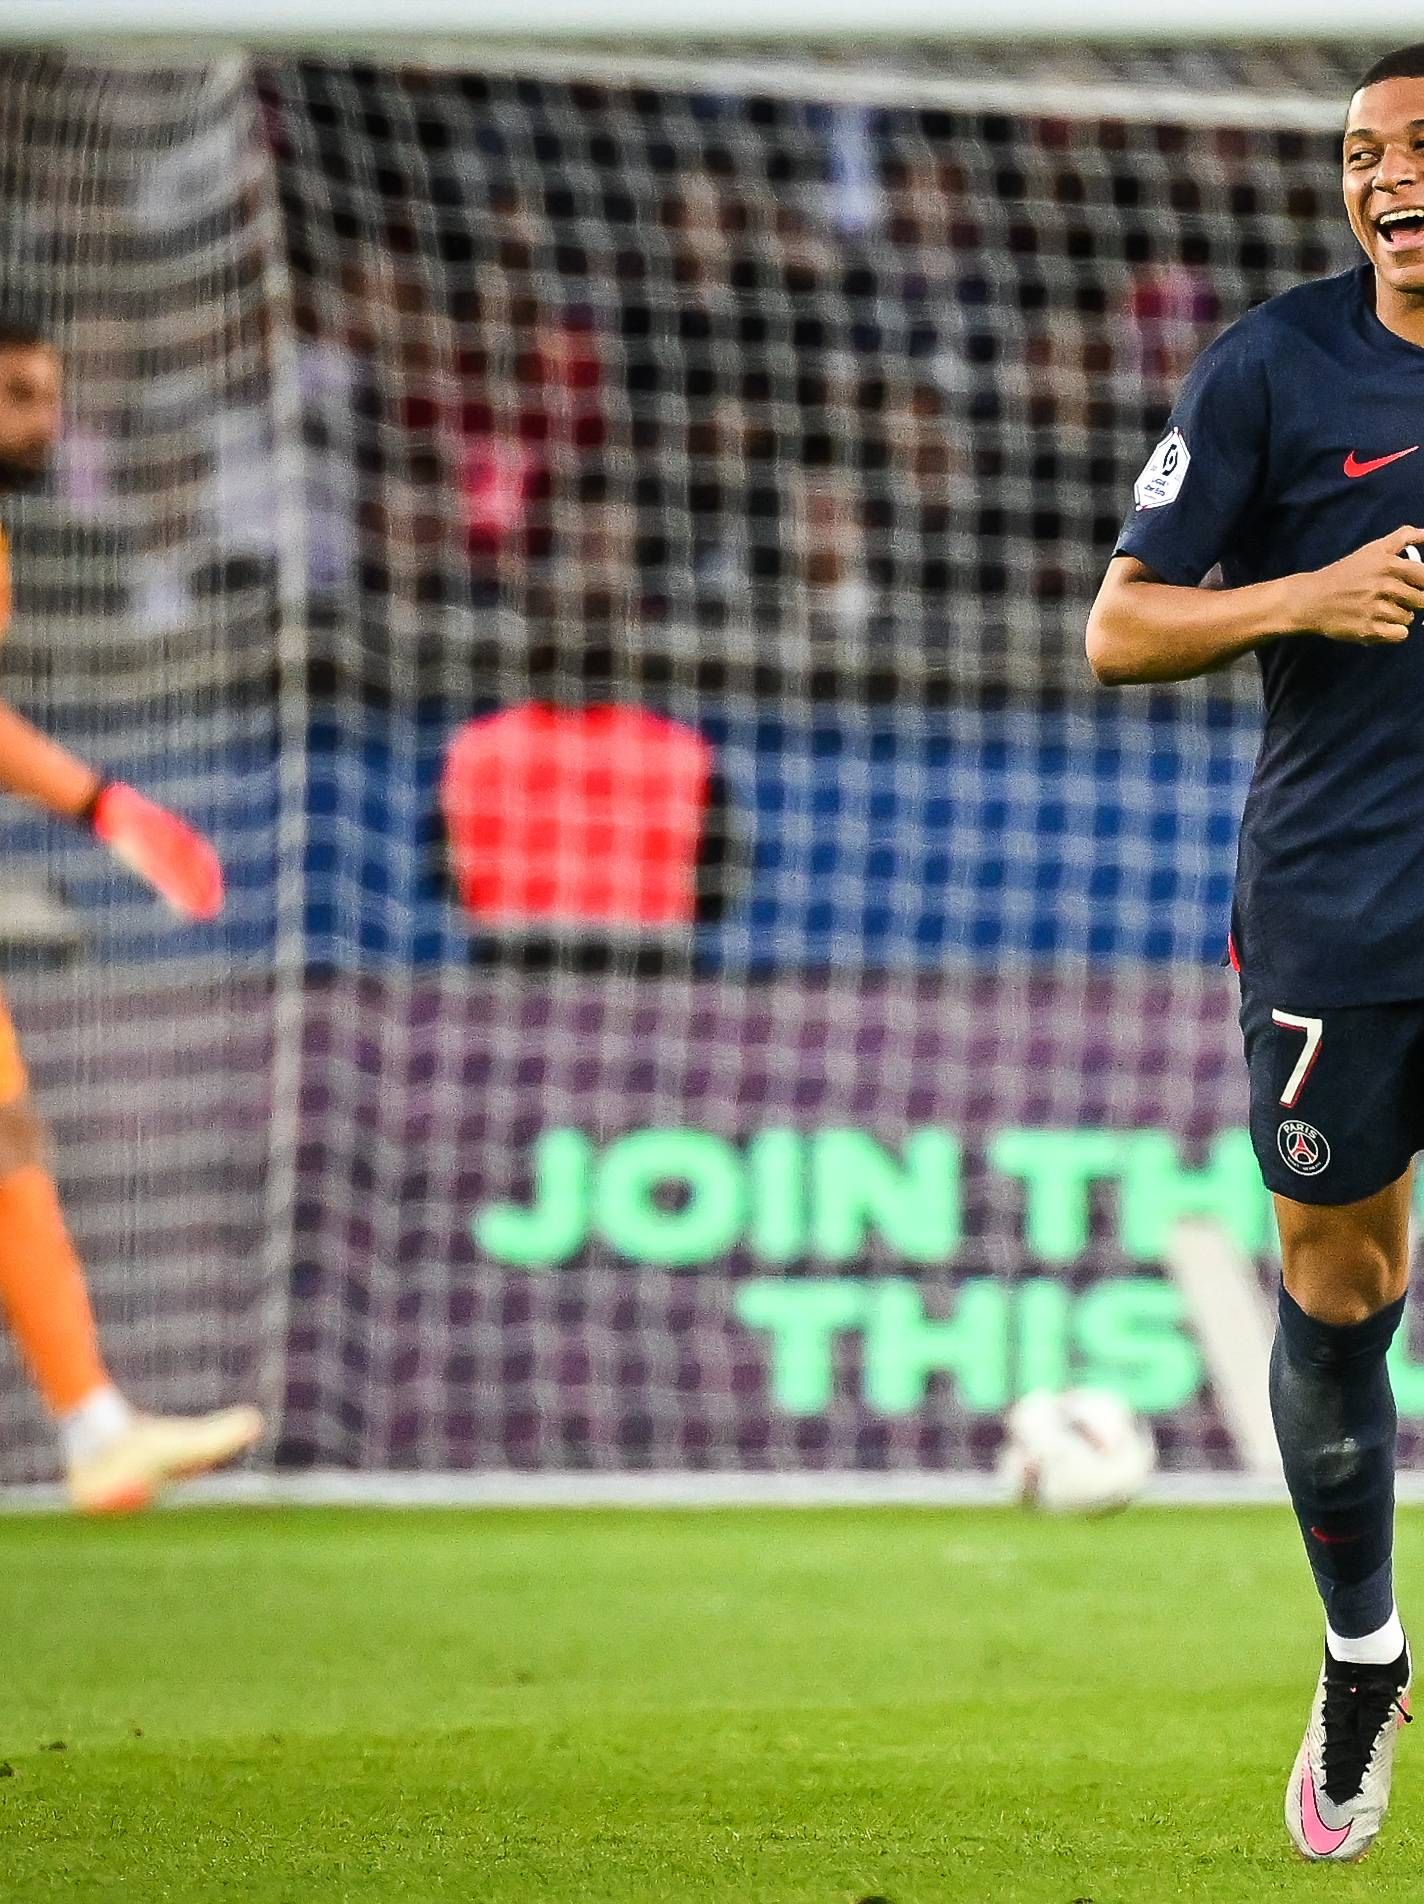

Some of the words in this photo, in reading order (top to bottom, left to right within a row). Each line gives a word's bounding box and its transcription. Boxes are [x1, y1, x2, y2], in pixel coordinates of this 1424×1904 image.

[1271, 1007, 1323, 1108] 7
[1283, 1123, 1318, 1139] PARIS
[472, 1127, 966, 1268] JOIN
[987, 1127, 1284, 1264] TH
[734, 1275, 1206, 1416] THIS
